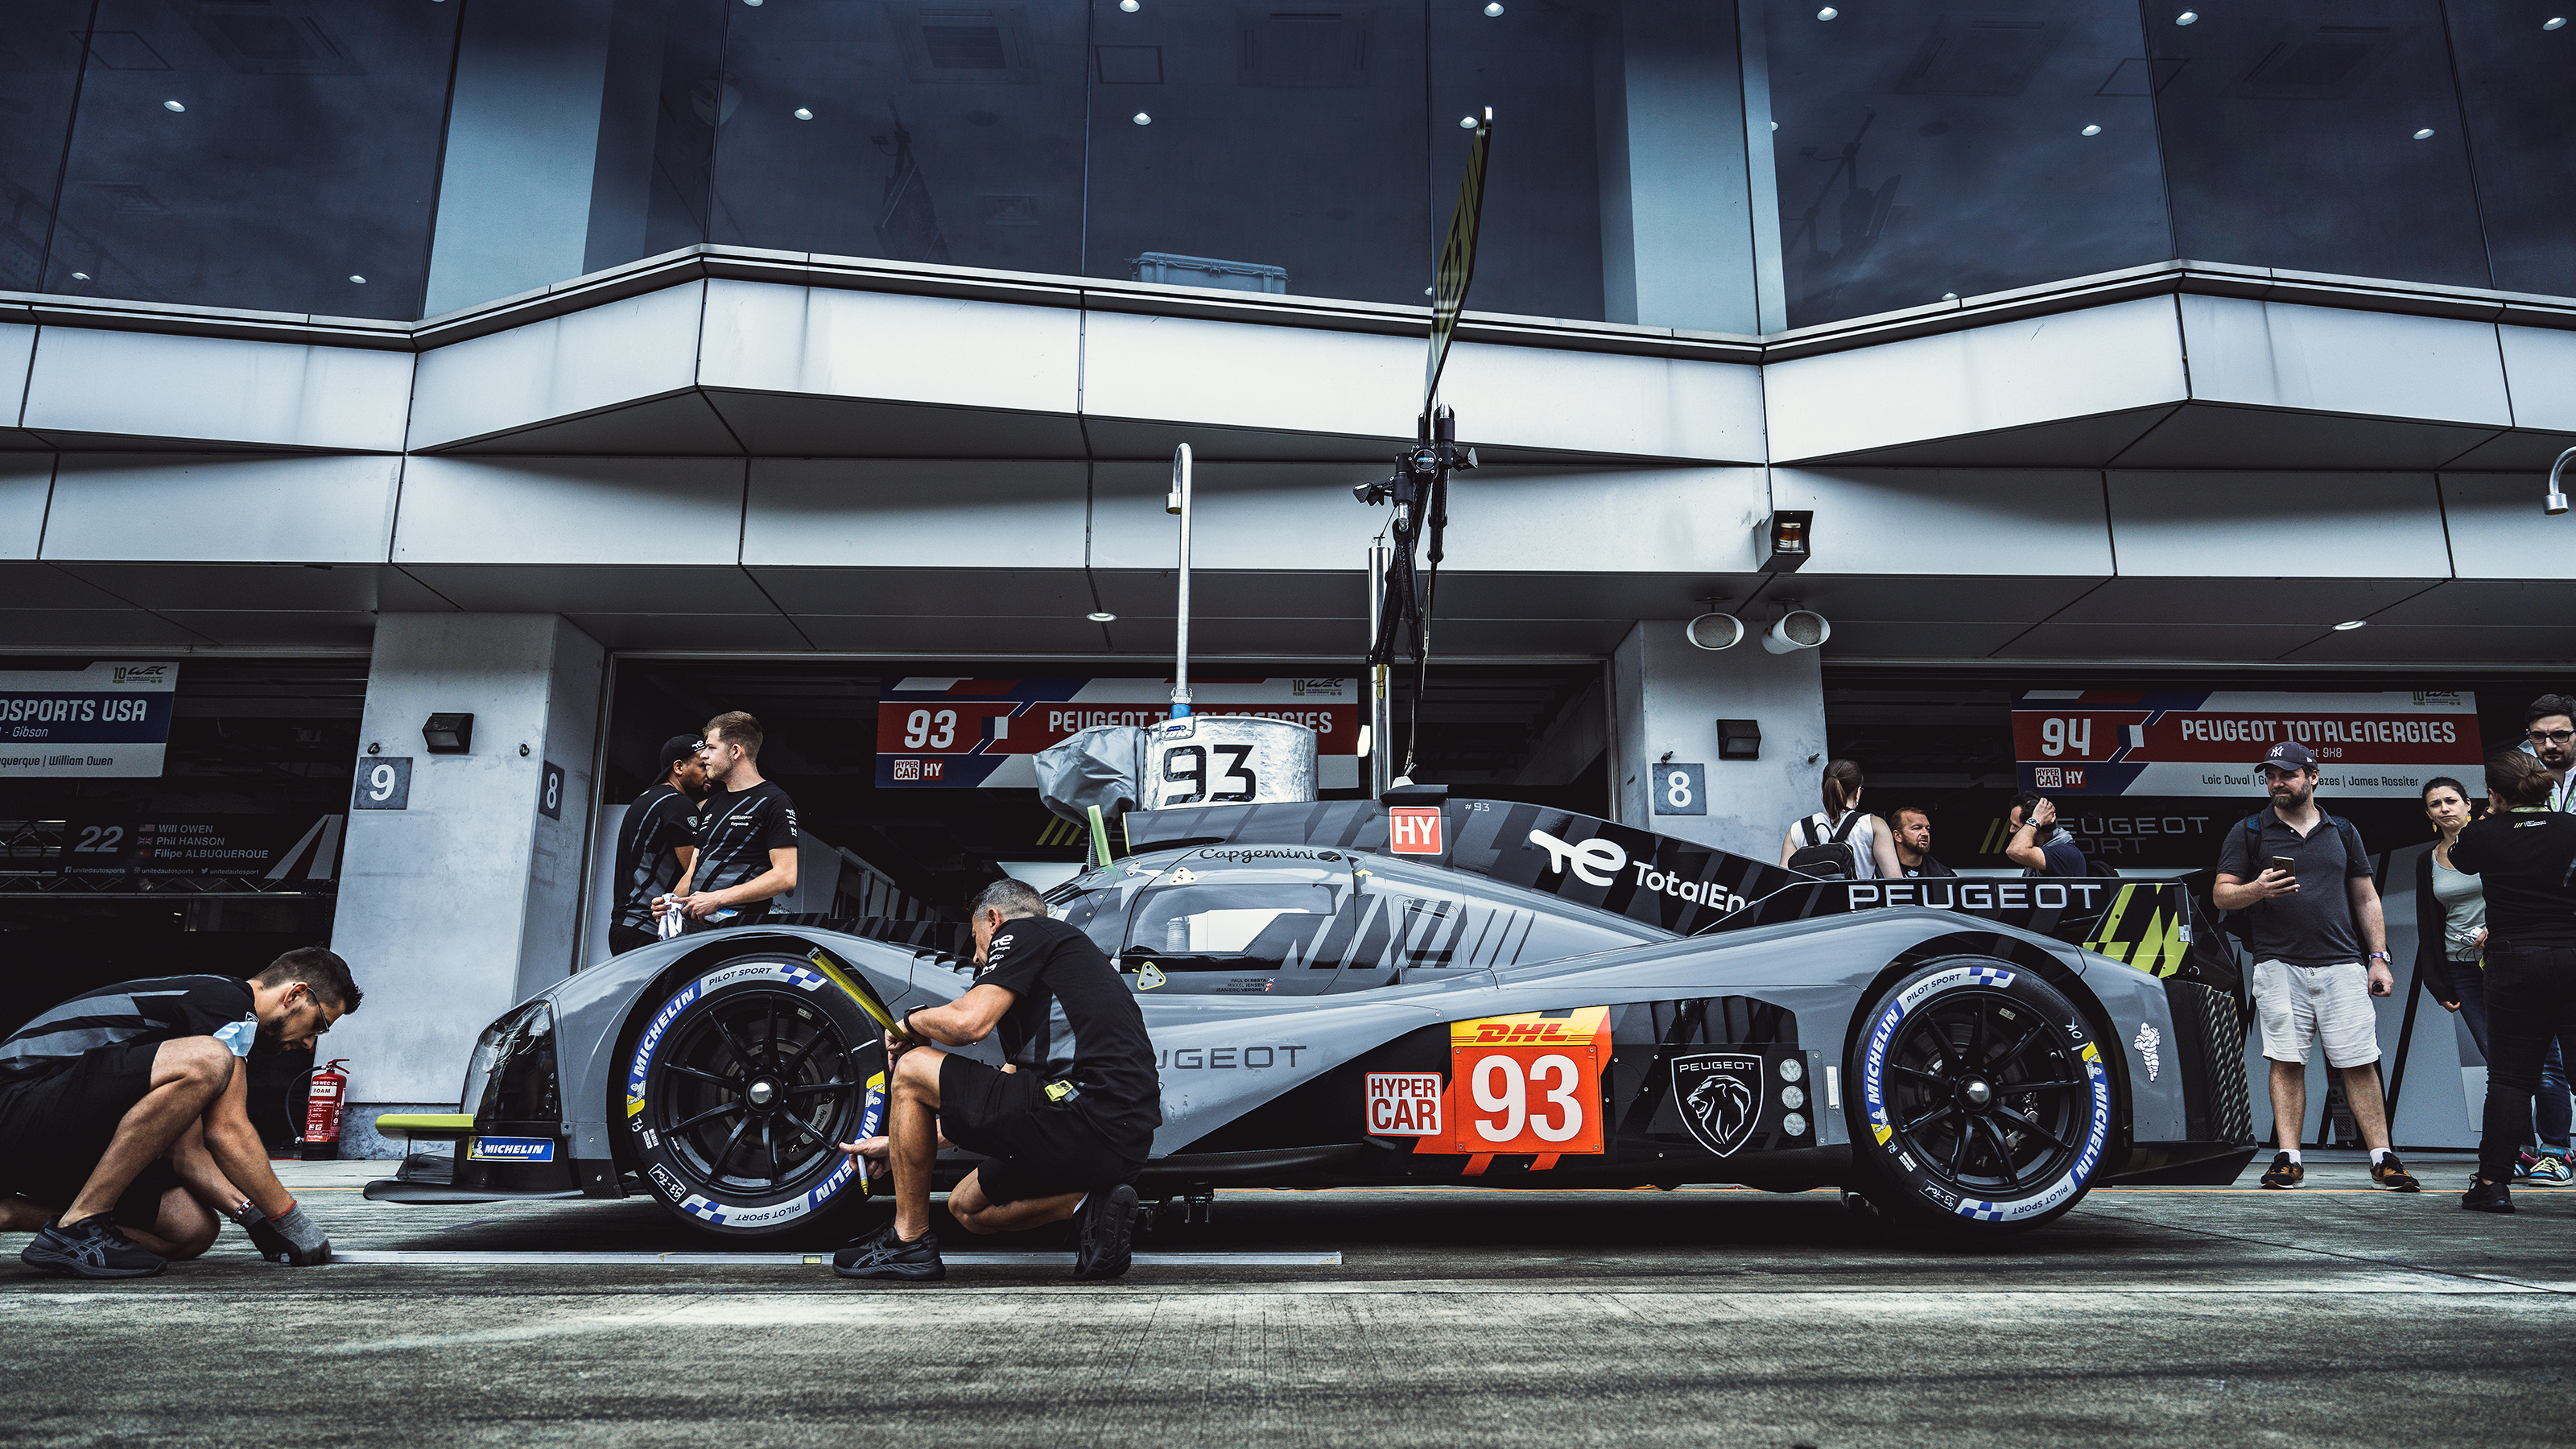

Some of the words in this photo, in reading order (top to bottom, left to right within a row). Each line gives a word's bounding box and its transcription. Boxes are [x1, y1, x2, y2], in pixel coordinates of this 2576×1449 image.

[114, 667, 127, 679] 10
[128, 666, 167, 675] WEC
[1292, 679, 1305, 691] 10
[1307, 678, 1344, 687] WEC
[101, 700, 147, 722] USA
[12, 725, 48, 737] Gibson
[904, 709, 958, 749] 93
[2041, 718, 2091, 756] 94
[2181, 719, 2277, 741] PEUGEOT
[2281, 720, 2456, 743] TOTALENERGIES
[49, 755, 84, 766] William
[86, 756, 114, 766] Owen
[894, 768, 919, 779] CAR
[923, 763, 943, 777] HY
[1163, 744, 1257, 806] 93
[2065, 771, 2083, 785] HY
[369, 764, 396, 801] 9
[2037, 776, 2061, 786] CAR
[2202, 774, 2221, 785] Loic
[2224, 774, 2250, 785] Duval
[2348, 776, 2379, 786] James
[2381, 776, 2418, 786] Rossiter
[546, 772, 559, 810] 8
[1668, 771, 1692, 807] 8
[159, 824, 177, 833] Will
[180, 824, 213, 834] OWEN
[1394, 815, 1437, 845] HY
[2055, 817, 2209, 835] EUGEOT
[74, 825, 124, 852] 22
[156, 836, 175, 845] Phil
[178, 836, 225, 846] HANSON
[2075, 837, 2147, 854] ORT
[154, 849, 183, 860] Filipe
[185, 850, 269, 859] ALBUQUERQUE
[1199, 848, 1315, 864] Capgemini
[142, 867, 194, 876] unitedautosports
[1633, 860, 1757, 913] TotalEn
[1848, 884, 2102, 910] PEUGEOT
[709, 972, 737, 986] PILOT
[738, 968, 772, 976] SPORT
[1906, 984, 1929, 1004] PILOT
[1931, 973, 1961, 988] SPORT
[634, 988, 694, 1078] MICHELIN
[1475, 1023, 1568, 1042] DHL
[1868, 1008, 1900, 1104] MICHELIN
[1679, 1061, 1755, 1073] PEUGEOT
[1371, 1078, 1436, 1098] HYPER
[1472, 1055, 1583, 1142] 93
[1372, 1099, 1438, 1130] CAR
[2075, 1081, 2107, 1180] MICHELIN
[485, 1144, 545, 1154] MICHELIN
[815, 1110, 878, 1203] MIELIN
[2045, 1184, 2069, 1205] PILOT
[735, 1212, 770, 1221] SPORT
[772, 1203, 801, 1218] PILOT
[2012, 1200, 2043, 1215] SPORT
